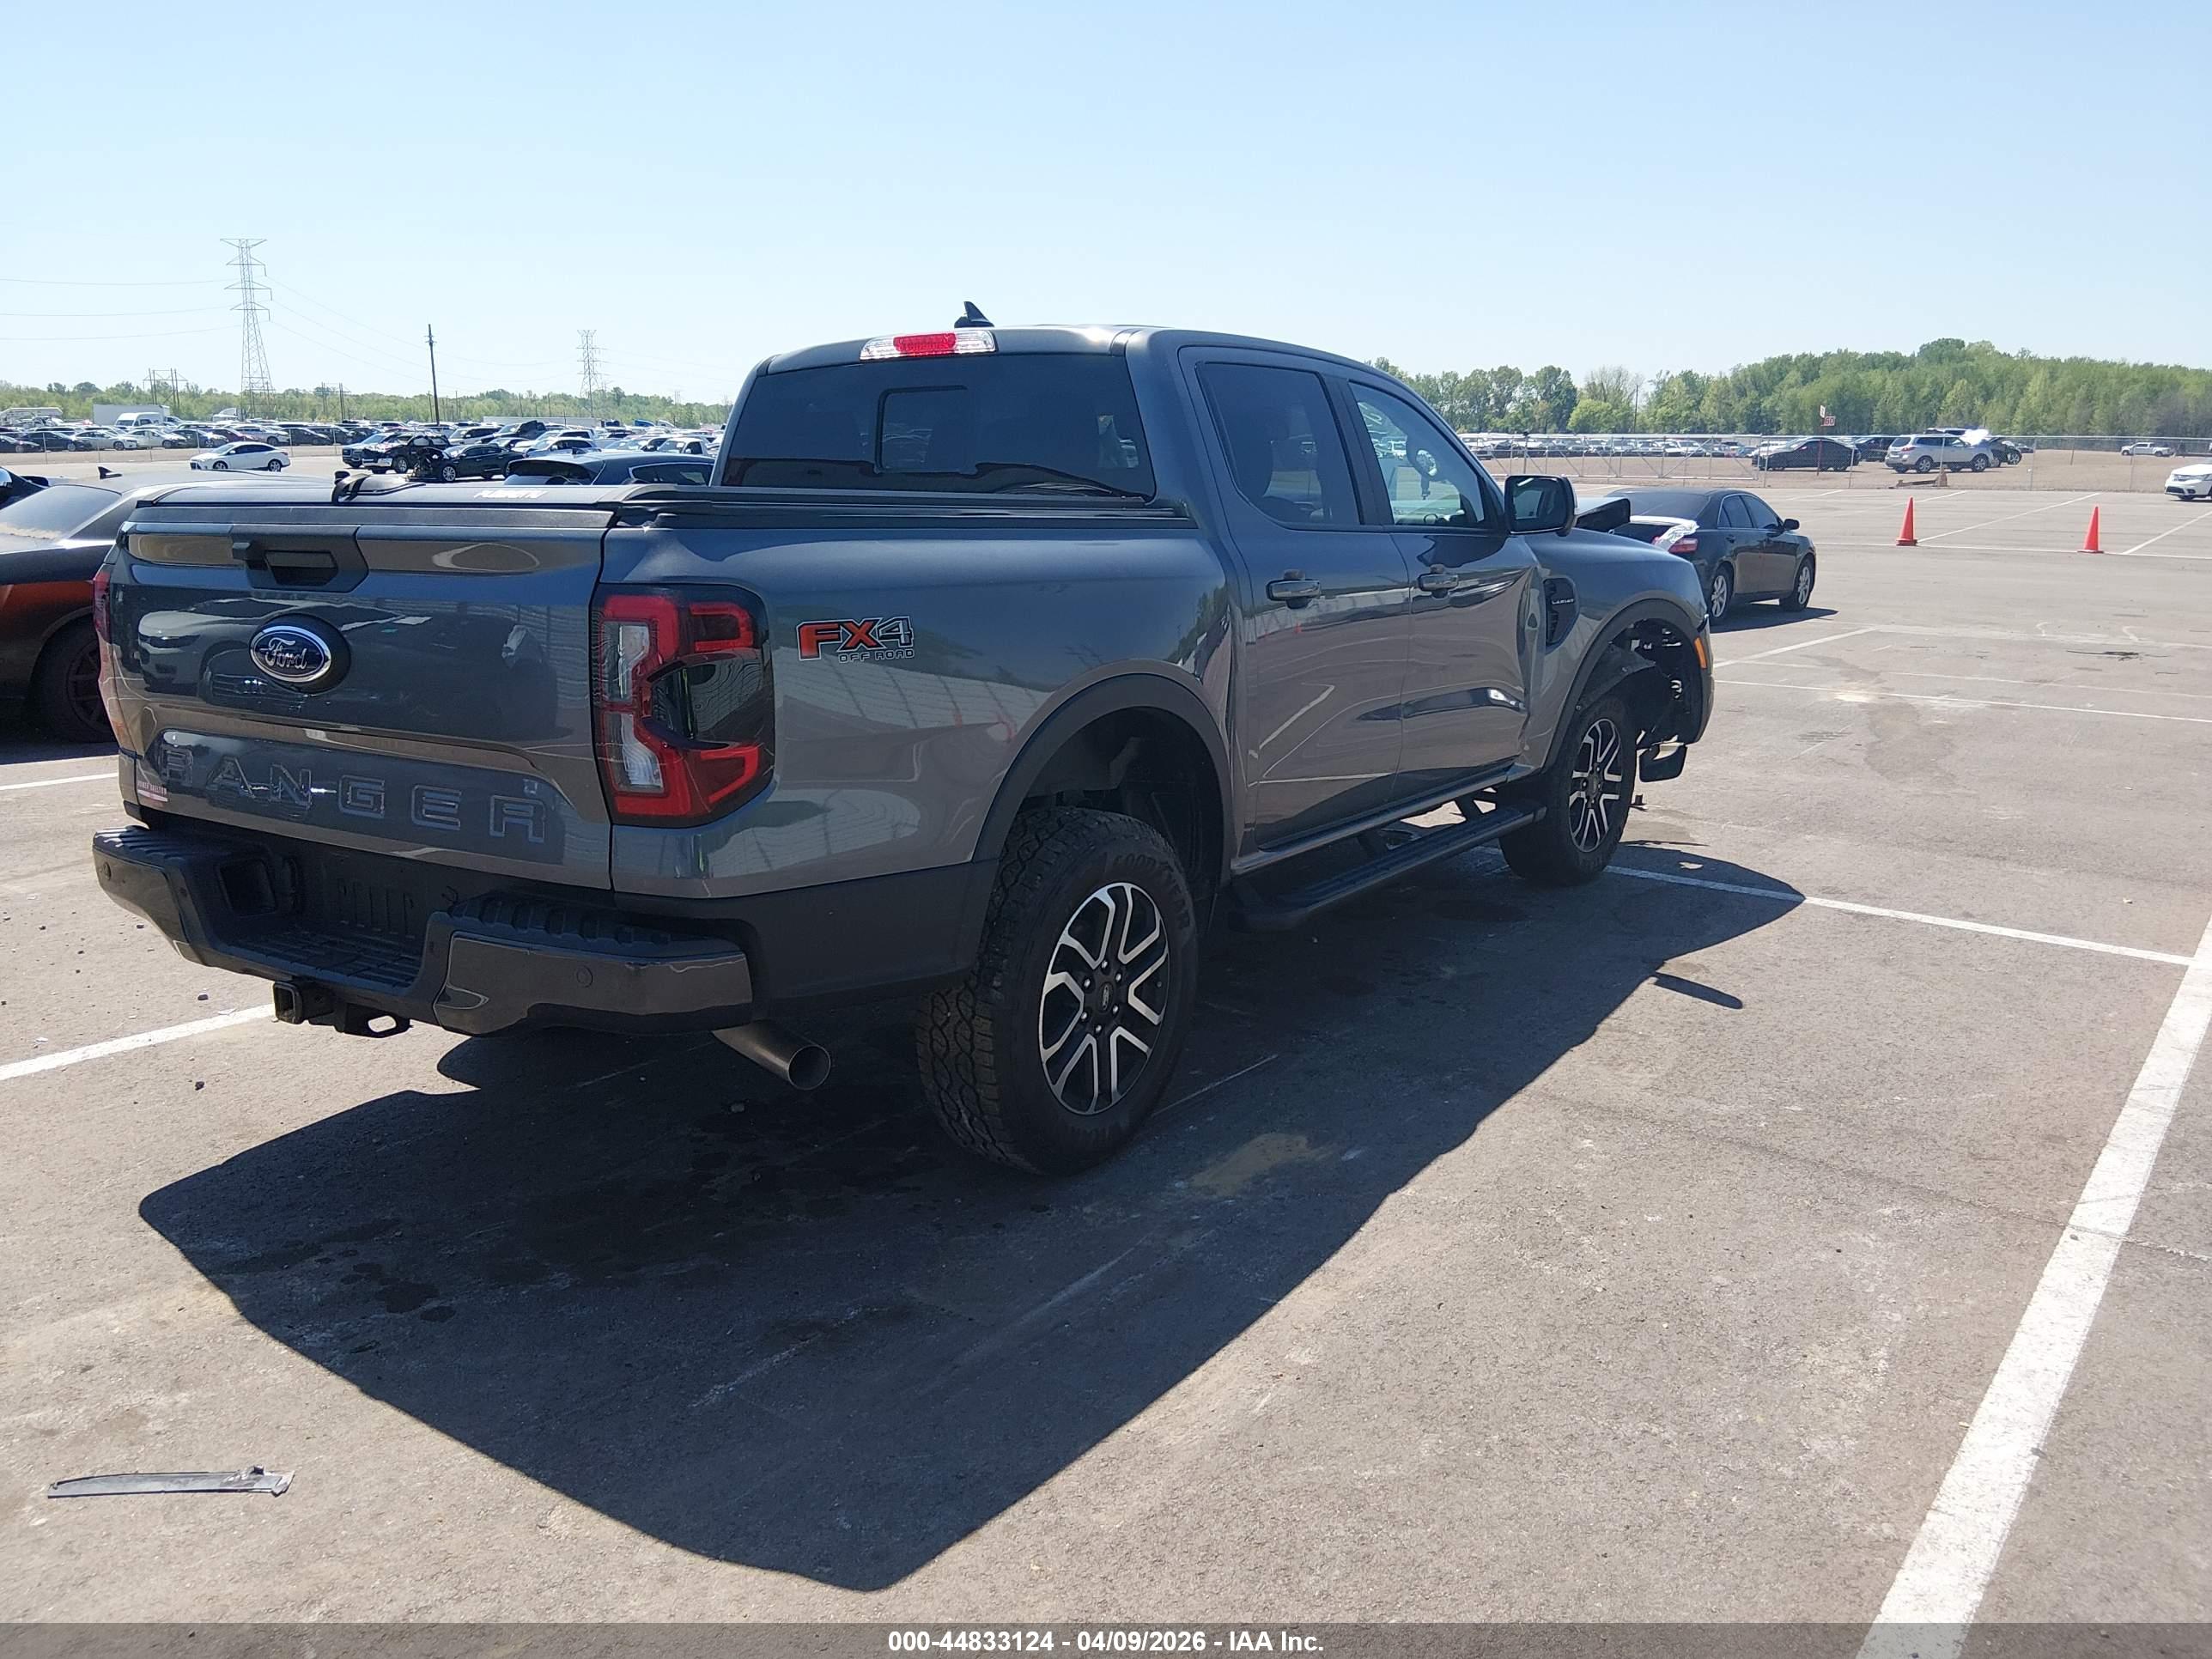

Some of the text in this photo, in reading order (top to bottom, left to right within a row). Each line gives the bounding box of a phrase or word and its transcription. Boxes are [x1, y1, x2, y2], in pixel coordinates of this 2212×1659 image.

[263, 636, 307, 670] Ford
[796, 616, 914, 660] FX4
[838, 649, 915, 663] OFF ROAD
[157, 744, 546, 842] RANGER
